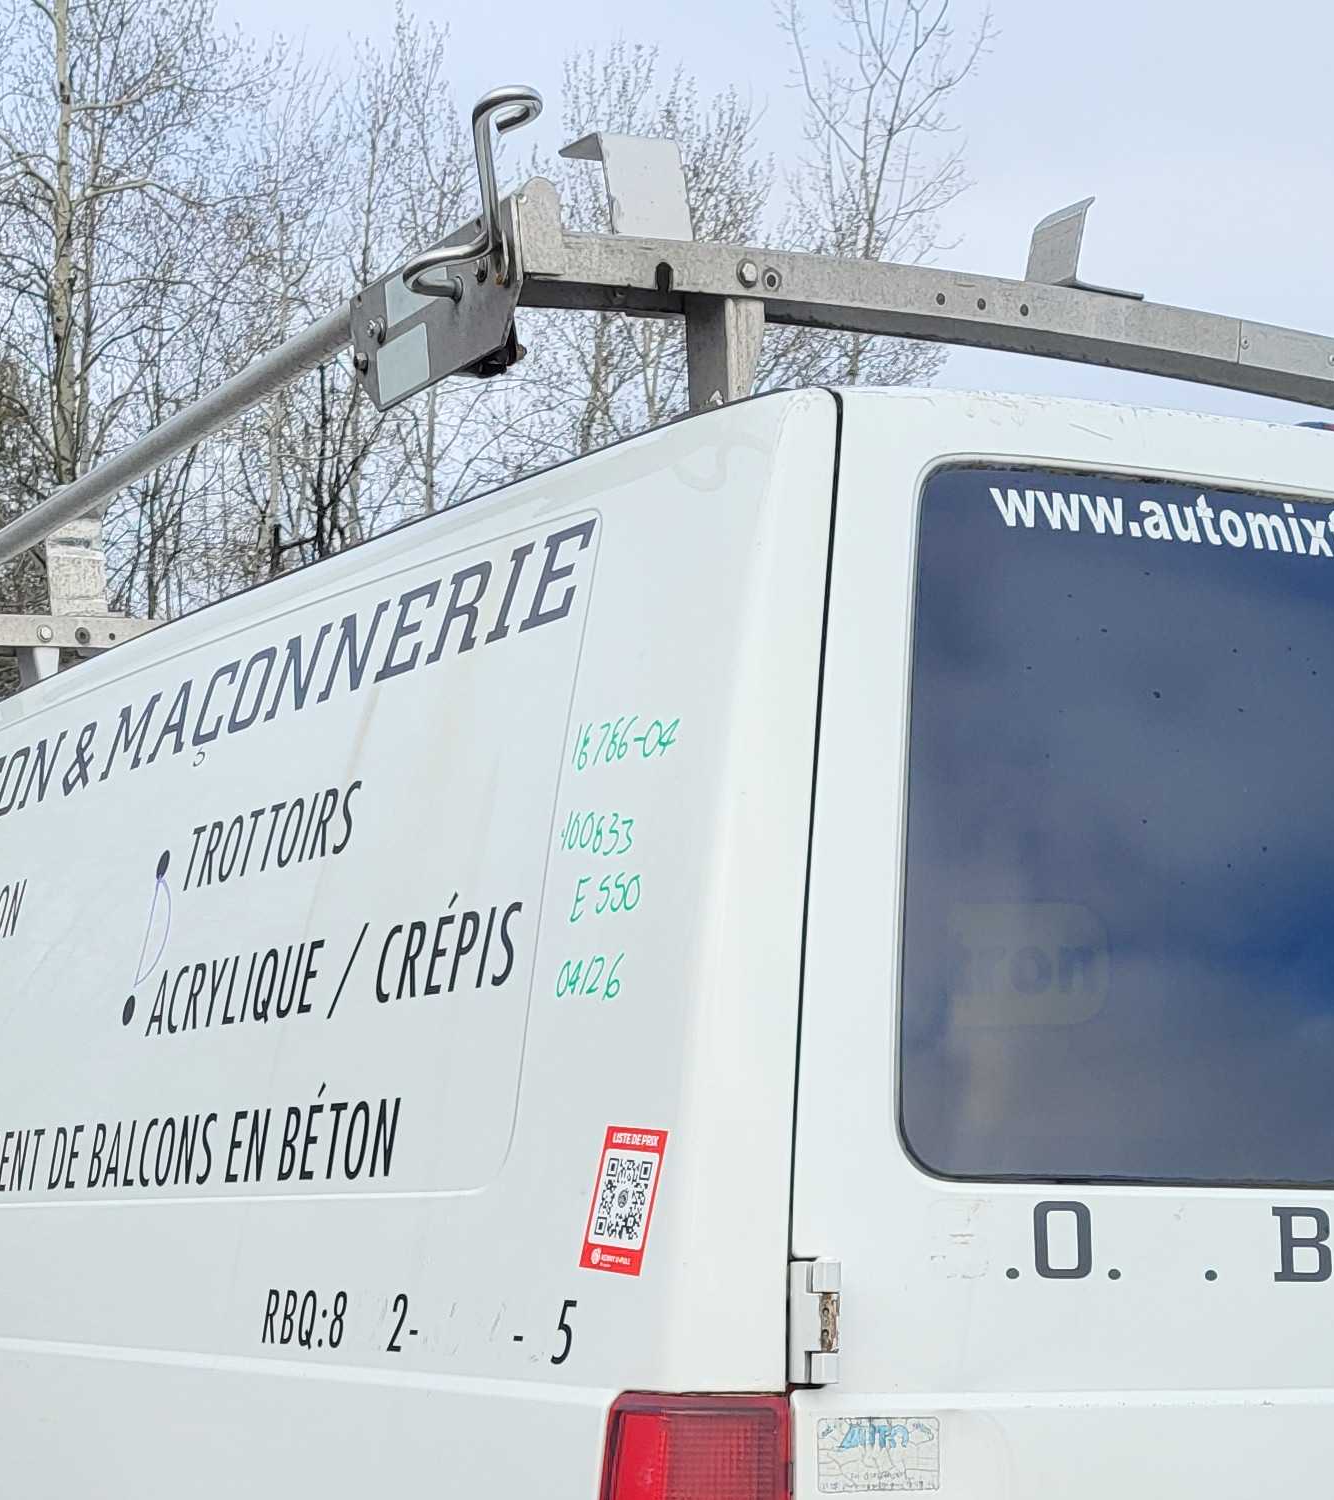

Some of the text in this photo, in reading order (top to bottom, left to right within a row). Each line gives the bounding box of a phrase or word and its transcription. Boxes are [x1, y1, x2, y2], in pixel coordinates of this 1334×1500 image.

[62, 721, 98, 797] &
[98, 517, 598, 782] MAÇONNERIE
[183, 780, 363, 892] TROTTOIRS
[144, 891, 523, 1037] ACRYLIQUE / CRÉPIS
[47, 1125, 85, 1190] DE
[87, 1112, 218, 1188] BALCONS
[224, 1108, 271, 1183] EN
[277, 1081, 402, 1182] BÉTON
[550, 1299, 577, 1365] 5
